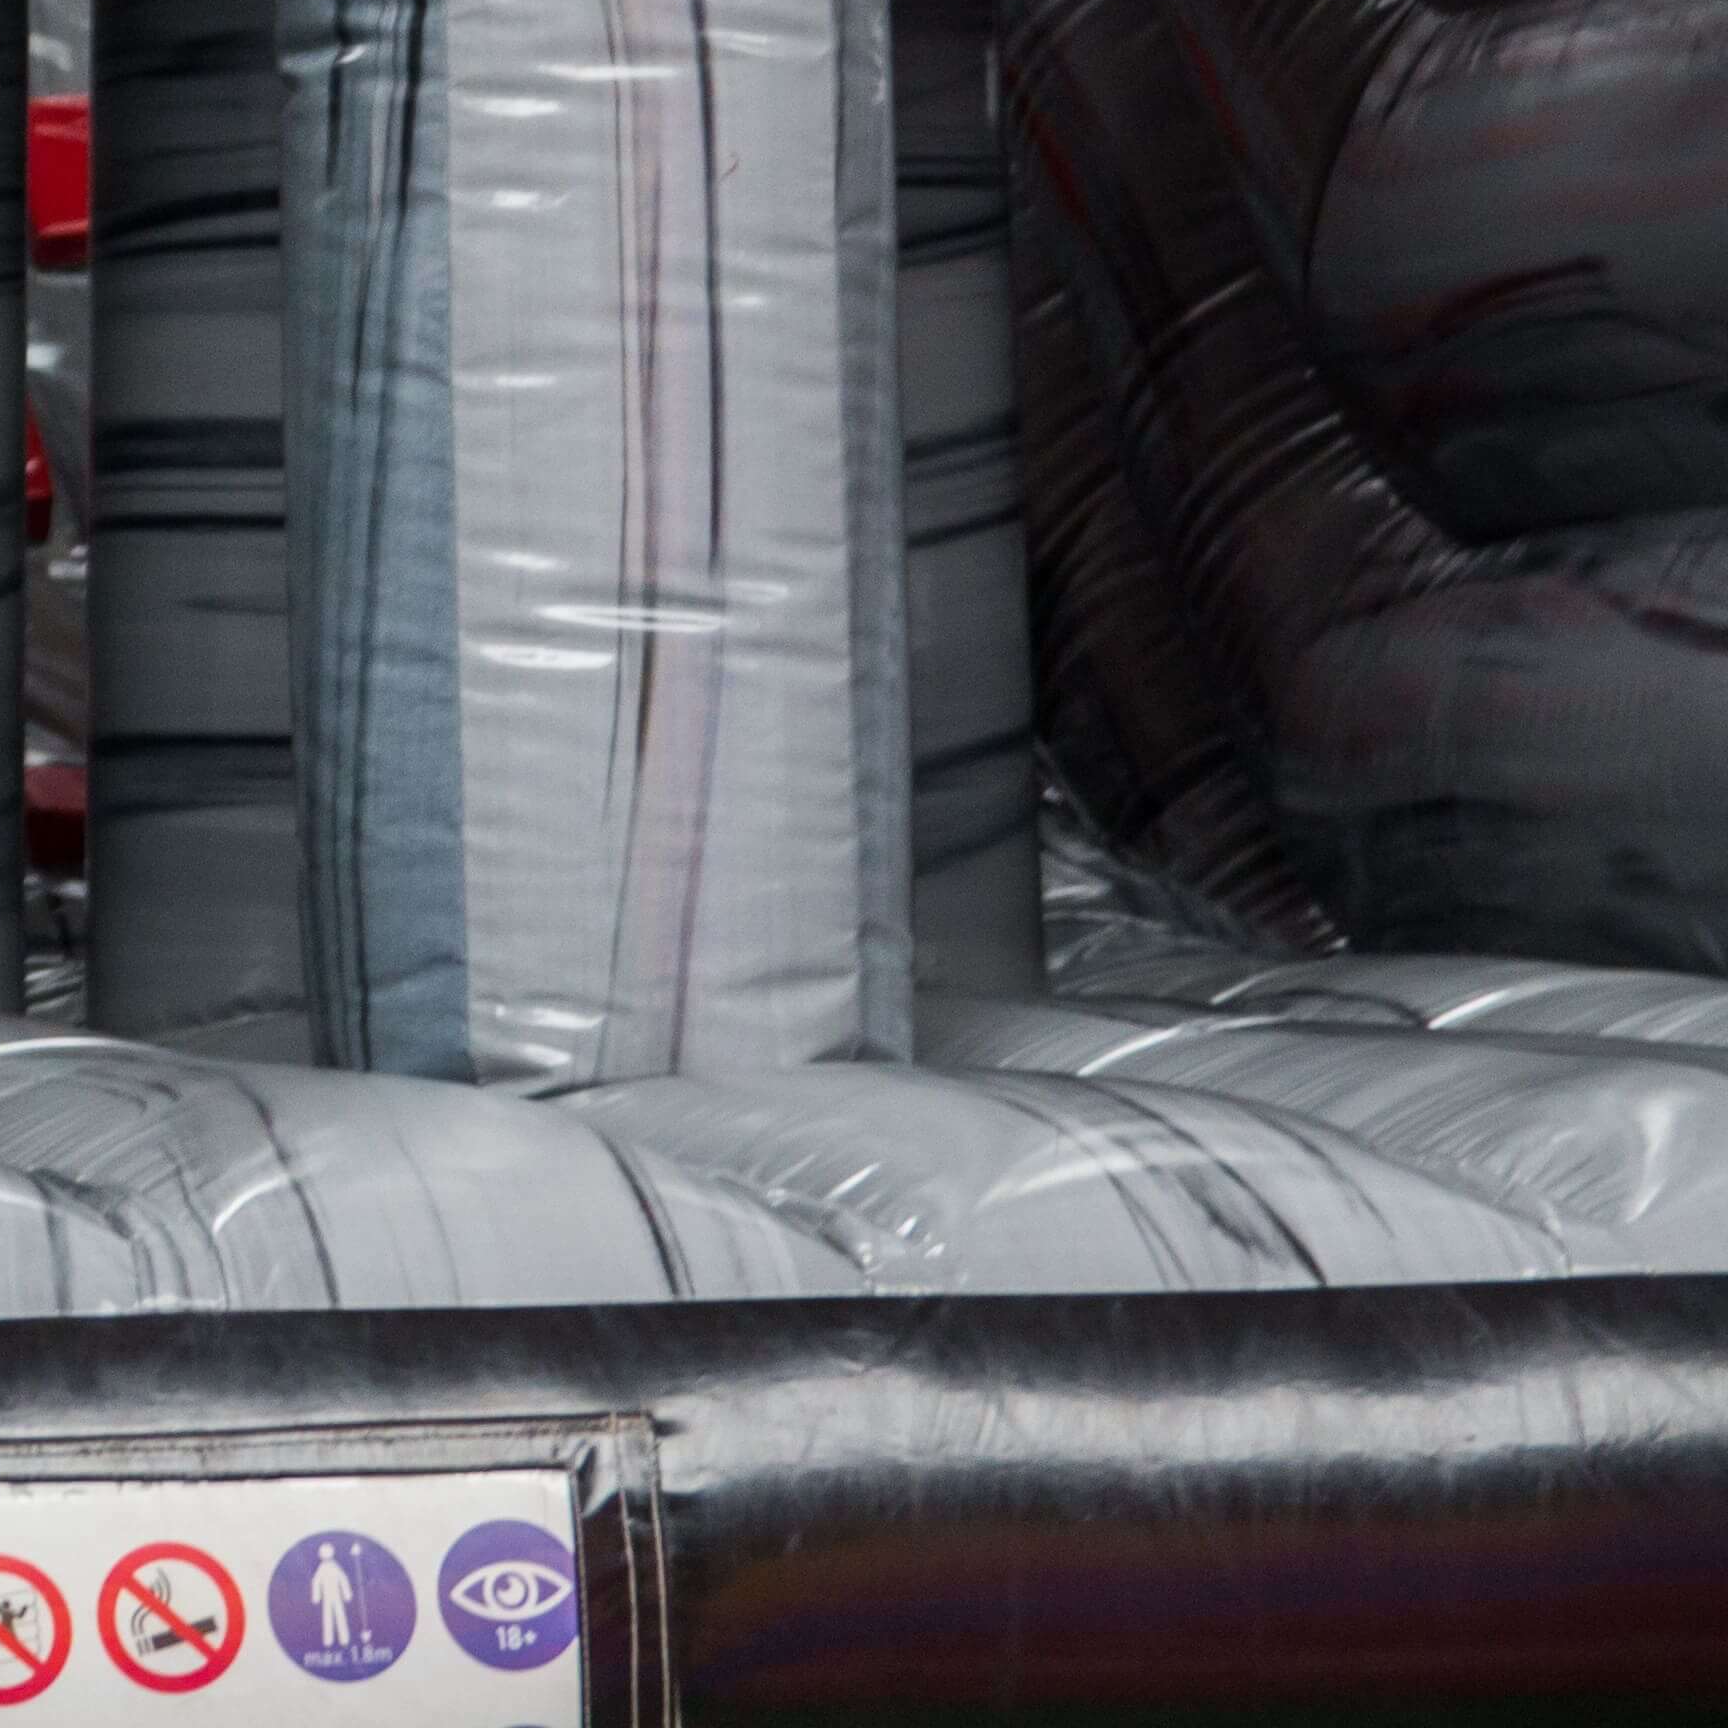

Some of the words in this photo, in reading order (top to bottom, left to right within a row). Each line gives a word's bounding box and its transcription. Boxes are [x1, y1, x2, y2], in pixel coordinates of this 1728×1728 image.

[494, 1624, 538, 1651] 18+
[303, 1648, 343, 1667] max
[349, 1643, 394, 1665] 1.8m
